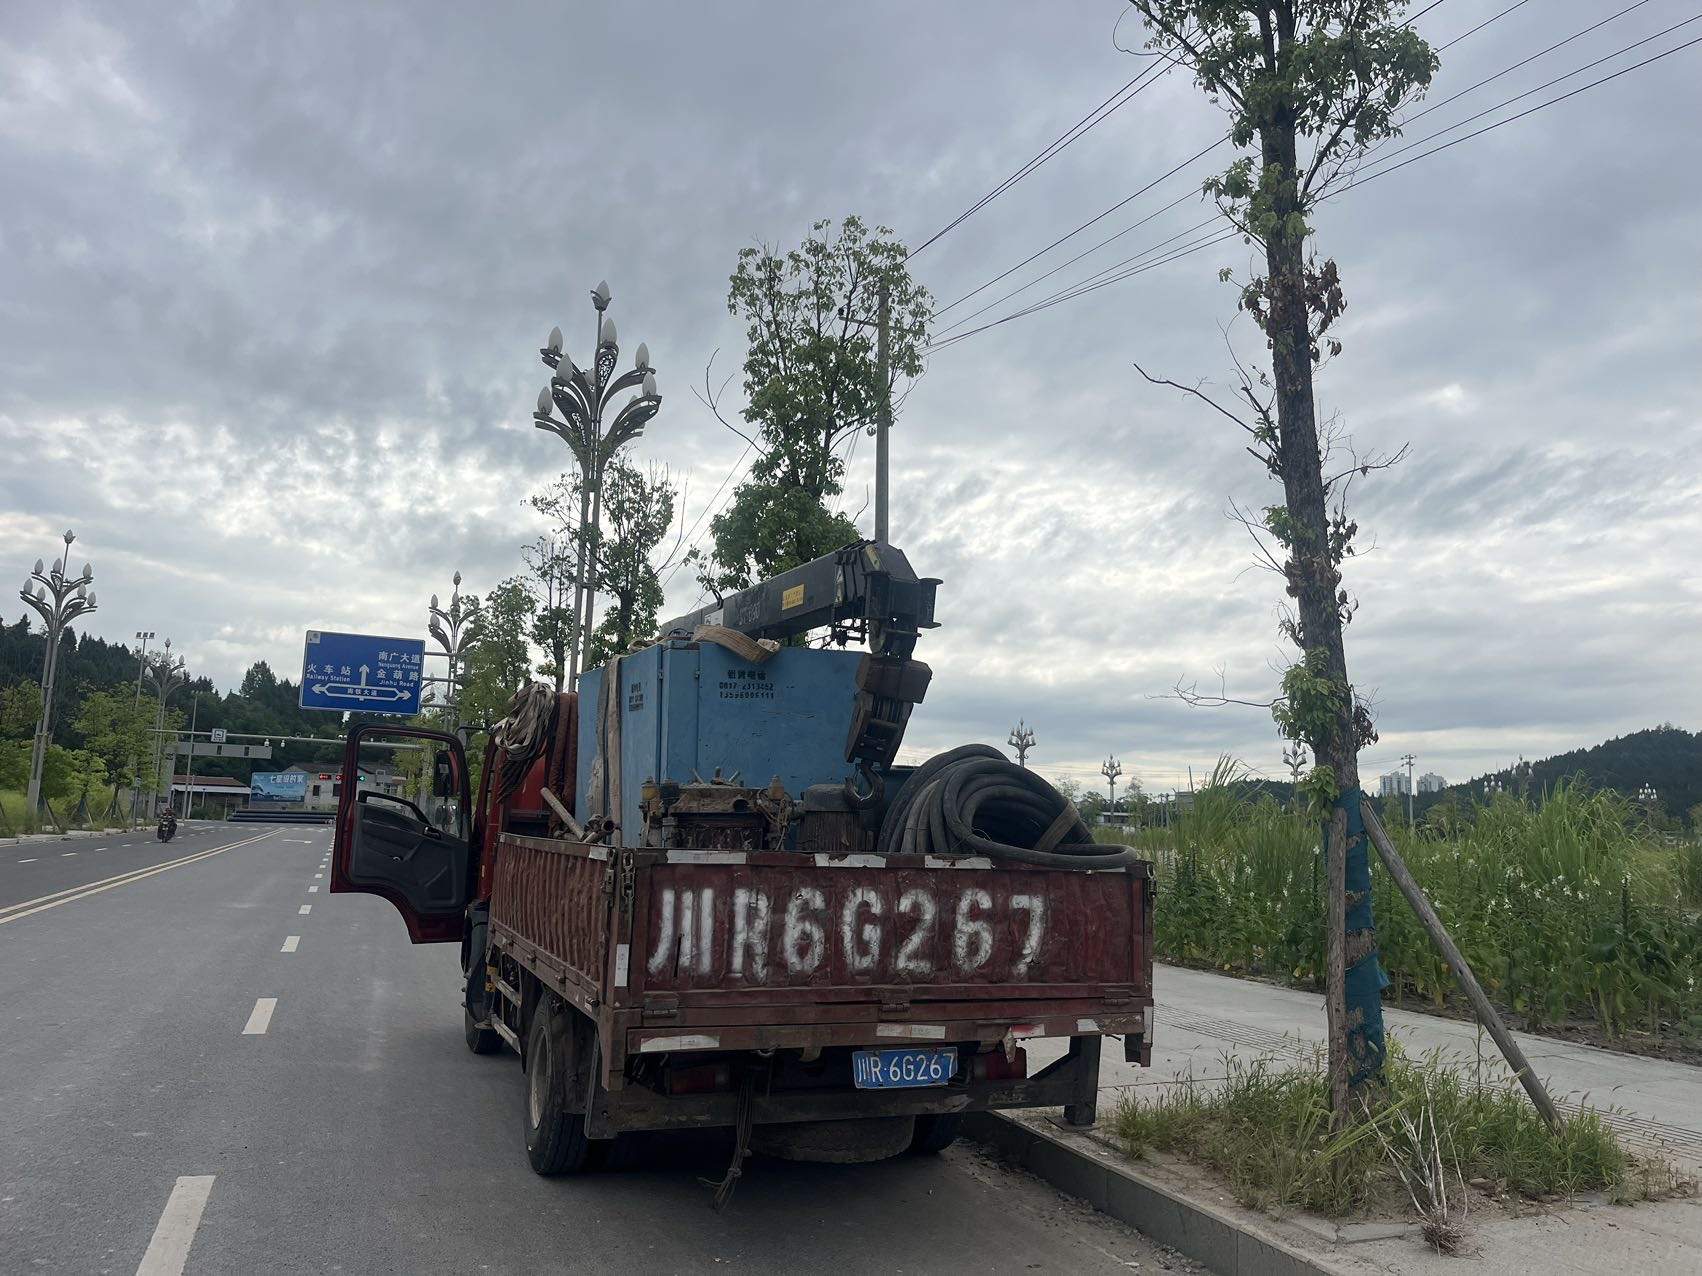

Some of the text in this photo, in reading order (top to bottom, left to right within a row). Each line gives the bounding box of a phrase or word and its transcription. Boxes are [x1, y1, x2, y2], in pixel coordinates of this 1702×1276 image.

[378, 650, 420, 664] 南广大道
[306, 663, 351, 676] 火车站
[306, 673, 329, 682] Railway
[648, 886, 1047, 984] 川R6G267
